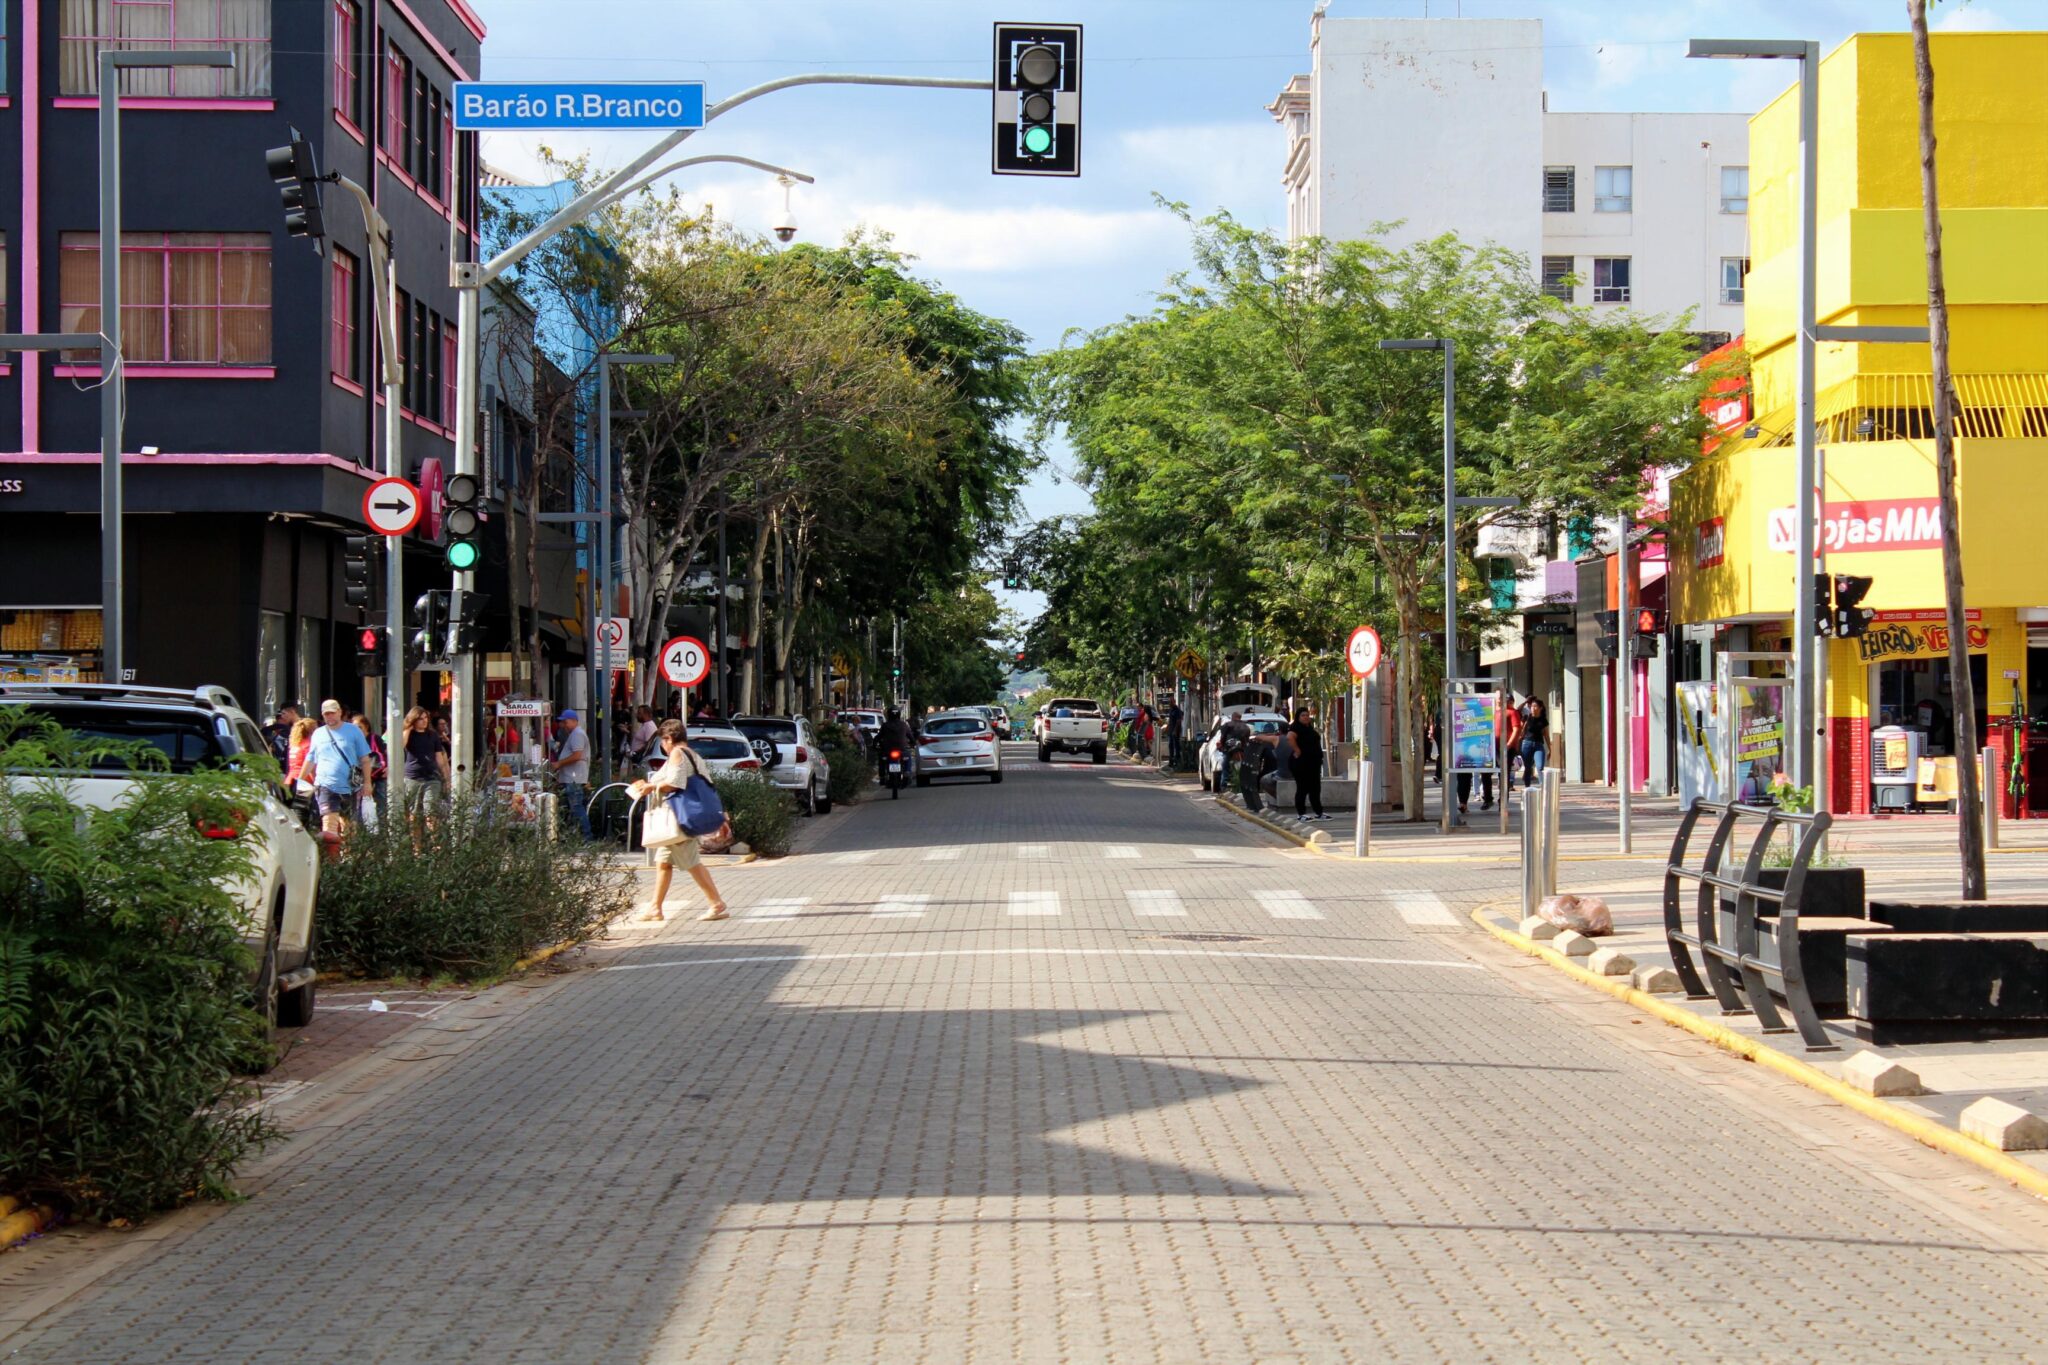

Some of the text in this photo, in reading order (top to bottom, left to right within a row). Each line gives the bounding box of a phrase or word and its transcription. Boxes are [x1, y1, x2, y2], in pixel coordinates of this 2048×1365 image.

[463, 93, 683, 119] Barão R.Branco
[0, 479, 22, 492] ss
[1824, 505, 1942, 551] ojasMM
[1353, 640, 1371, 657] 40
[1861, 624, 1916, 660] FEIRÃO
[671, 650, 697, 667] 40
